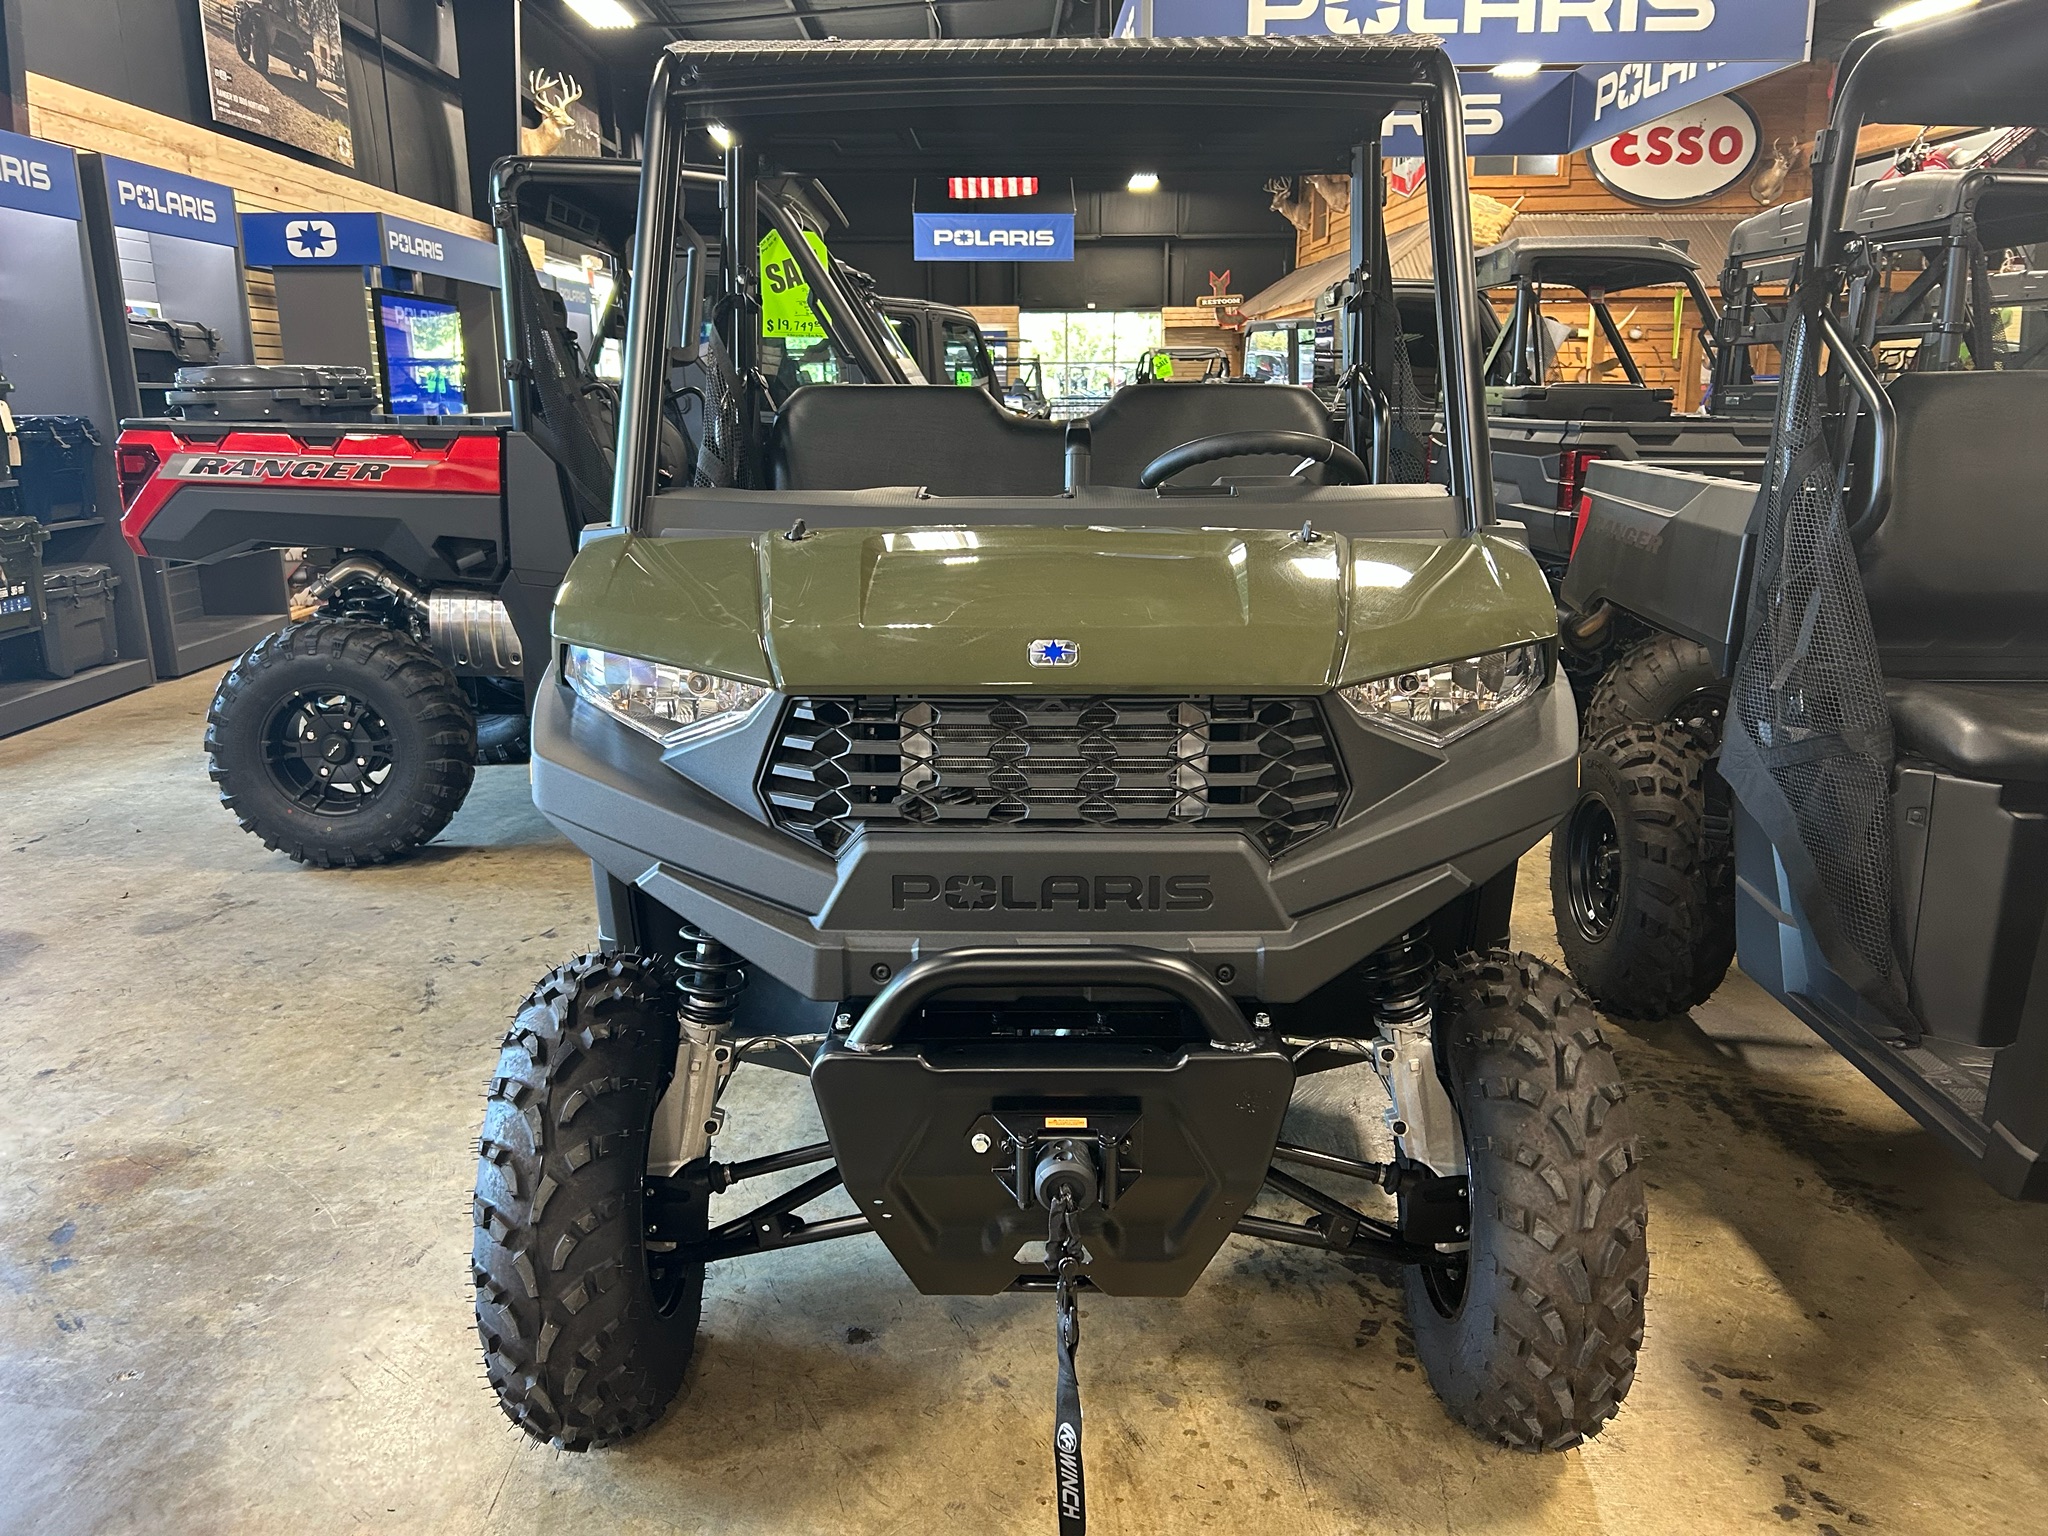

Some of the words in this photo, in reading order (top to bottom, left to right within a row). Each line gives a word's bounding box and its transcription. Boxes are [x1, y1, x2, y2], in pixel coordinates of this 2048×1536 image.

[1246, 0, 1716, 34] POLARIS
[1610, 125, 1744, 167] ESSO
[117, 179, 217, 224] POLARIS
[388, 230, 444, 262] POLARIS
[933, 229, 1055, 247] POLARIS
[1155, 359, 1169, 370] SALE
[188, 456, 391, 482] RANGER
[891, 874, 1214, 912] POLARIS
[1060, 1452, 1081, 1520] WINCH
